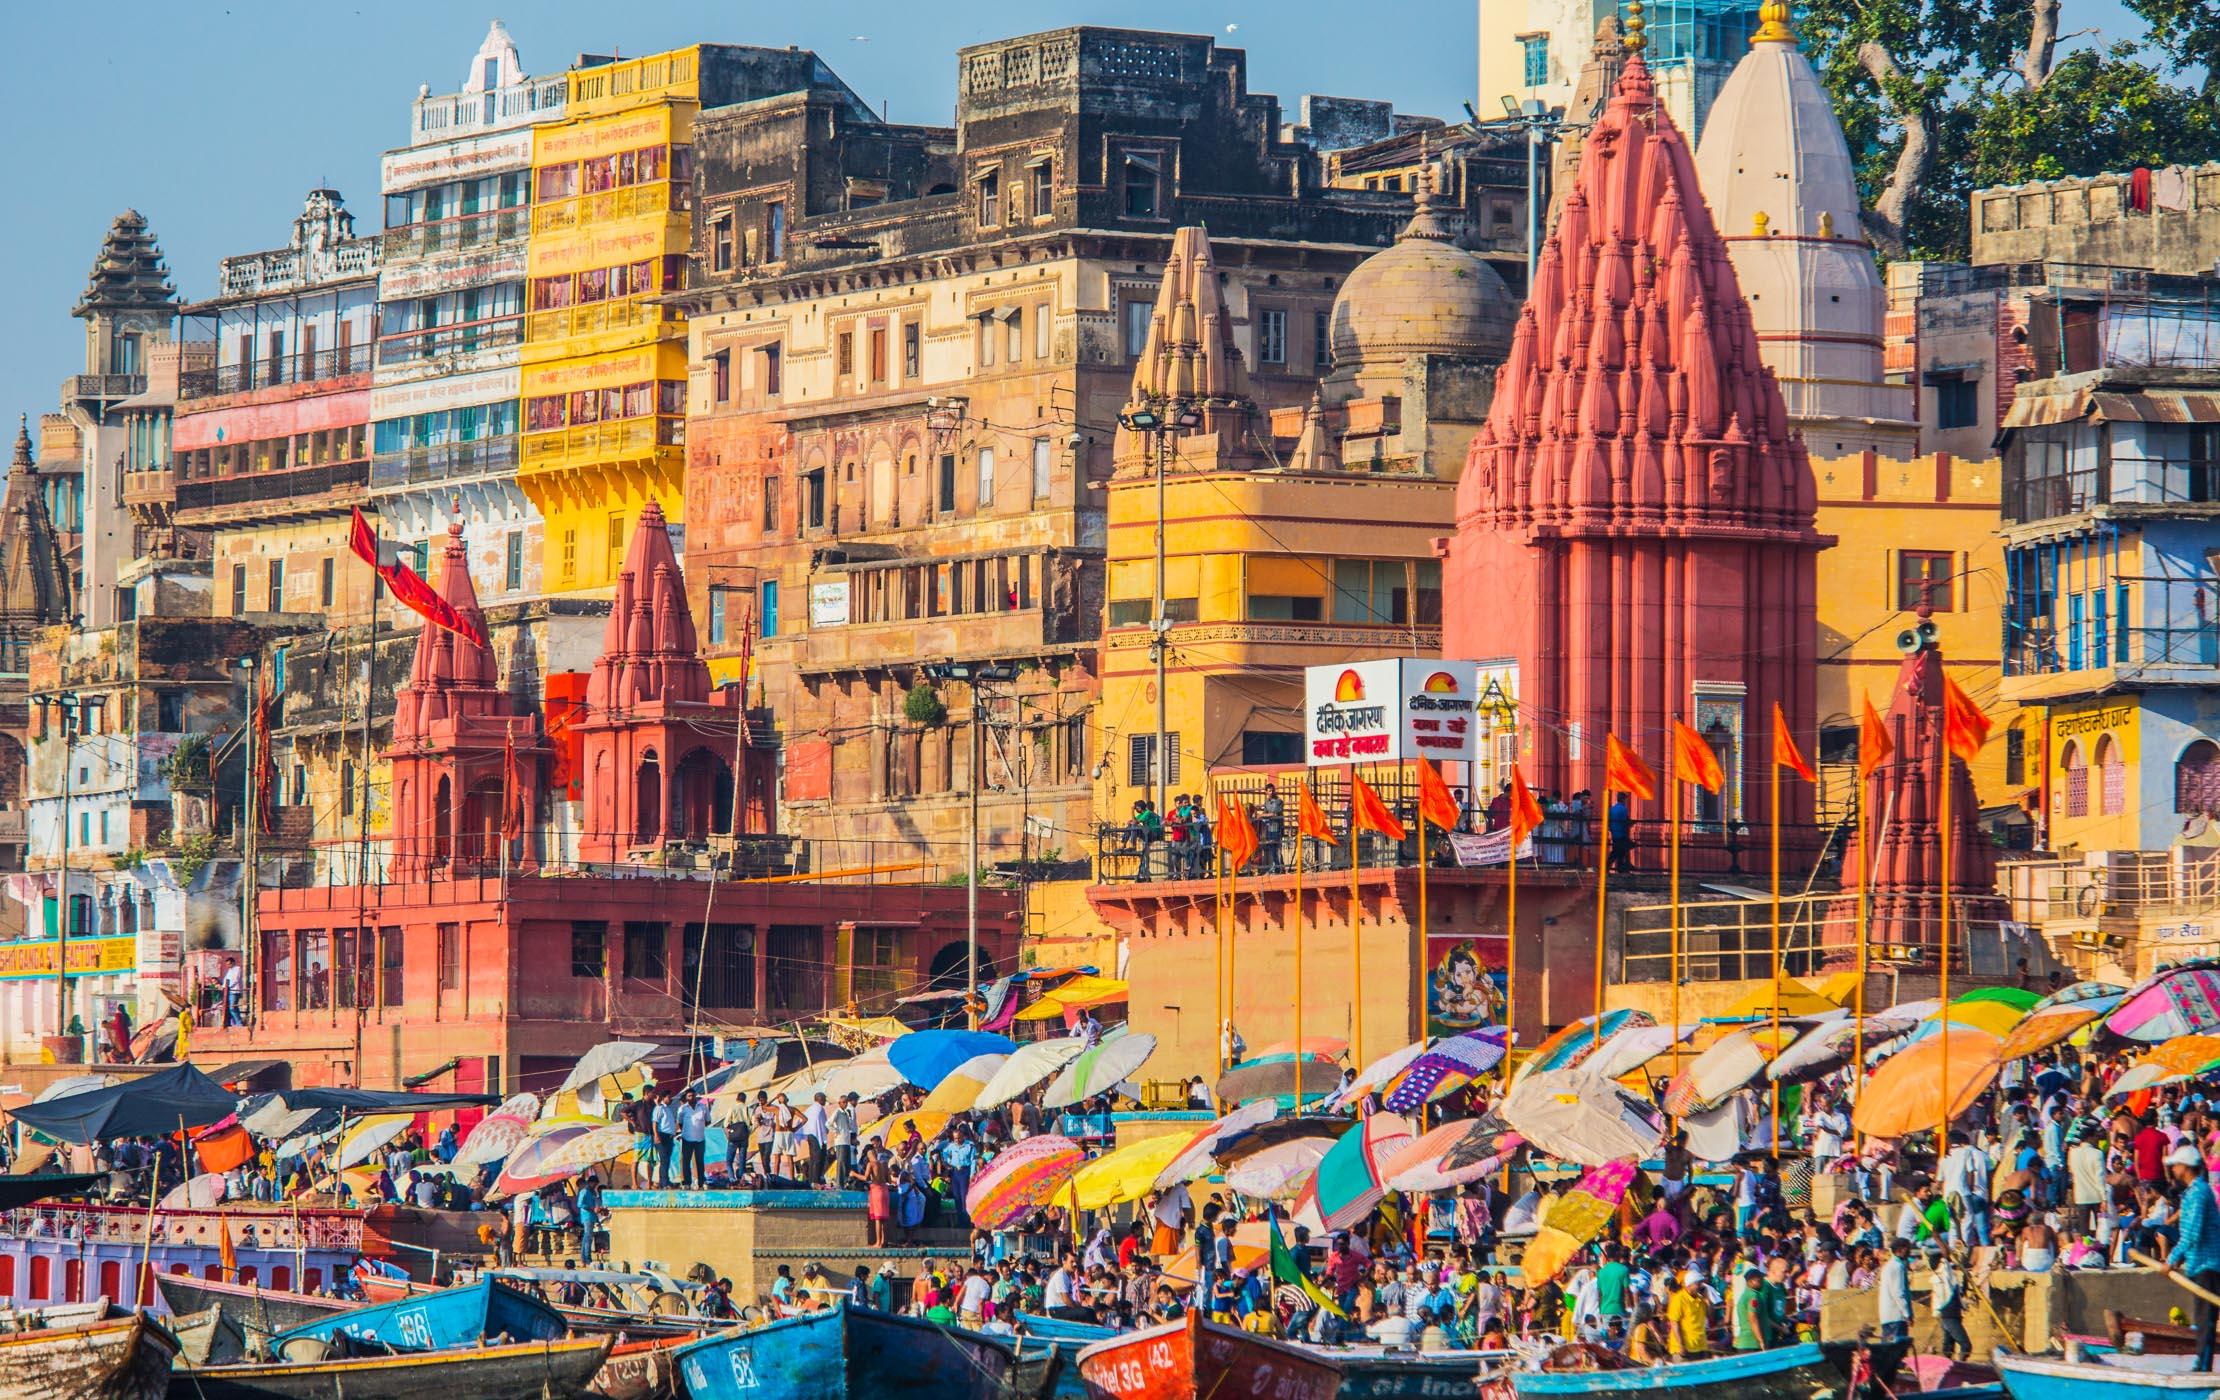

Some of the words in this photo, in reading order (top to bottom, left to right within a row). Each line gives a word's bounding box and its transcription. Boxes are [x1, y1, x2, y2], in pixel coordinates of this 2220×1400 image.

[1316, 703, 1345, 733] दैनिक
[1345, 706, 1386, 731] जागरण
[1408, 695, 1436, 710] दैनिक
[1437, 699, 1473, 712] जागरण
[2111, 707, 2131, 727] घाट
[400, 1313, 430, 1347] 196
[1120, 1360, 1146, 1392] 3G
